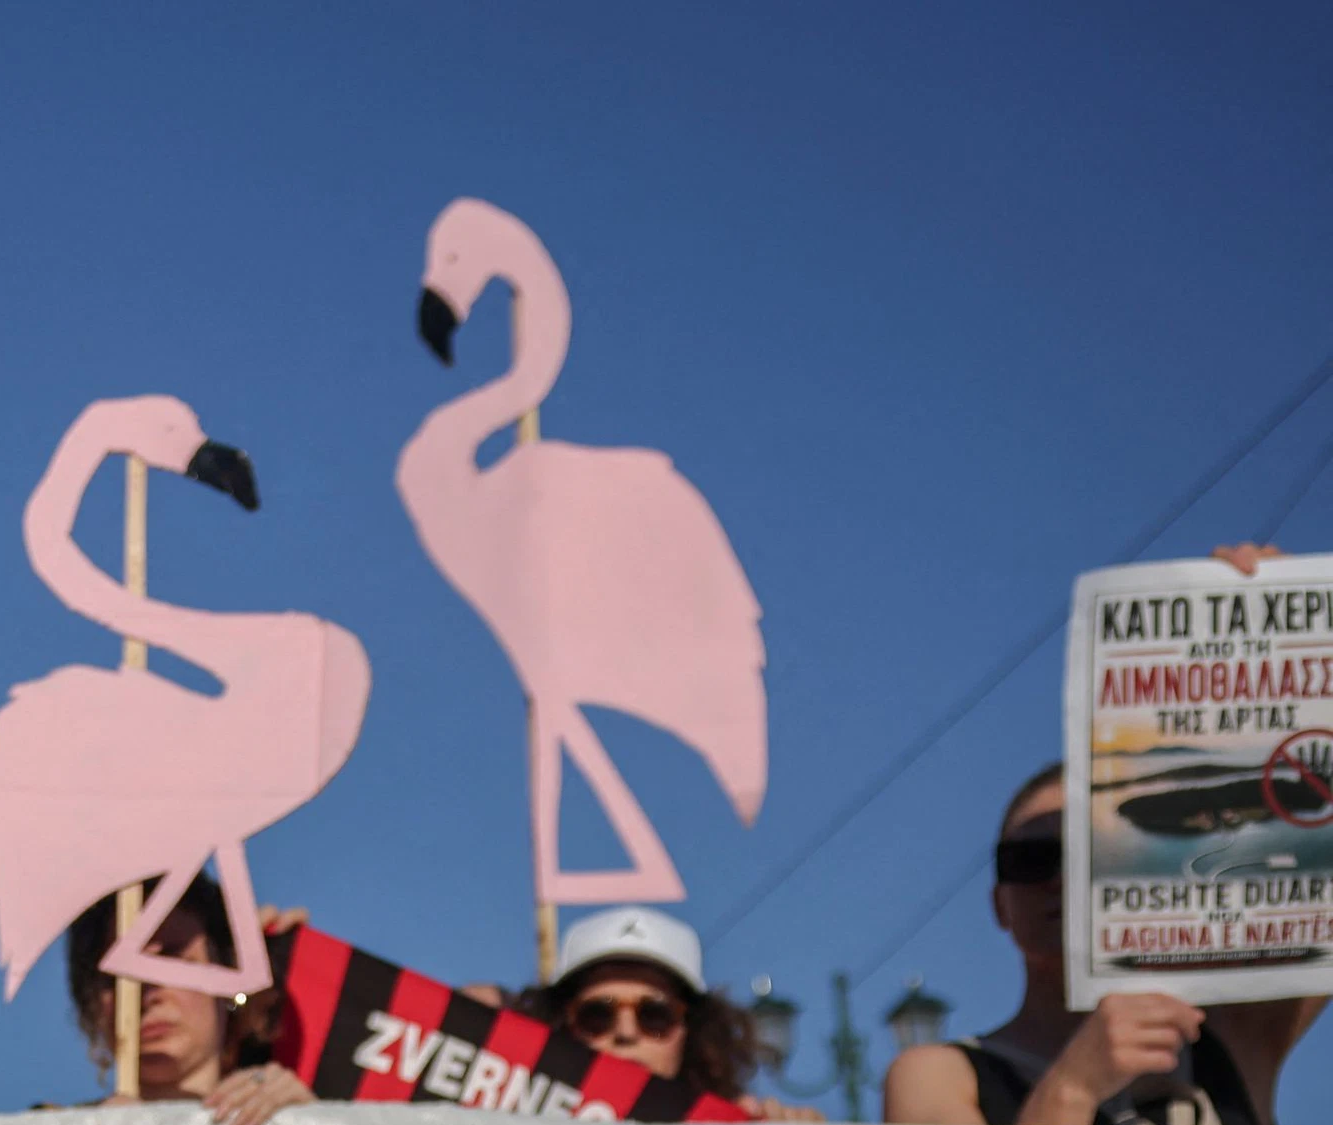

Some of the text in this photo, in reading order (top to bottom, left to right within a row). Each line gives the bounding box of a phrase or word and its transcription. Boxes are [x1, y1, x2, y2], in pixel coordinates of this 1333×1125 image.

[1102, 597, 1191, 642] ΚΑΤΩ
[1207, 594, 1248, 635] ΤΑ
[1158, 705, 1300, 735] ΤΗΣ ΑΡΤΑΣ
